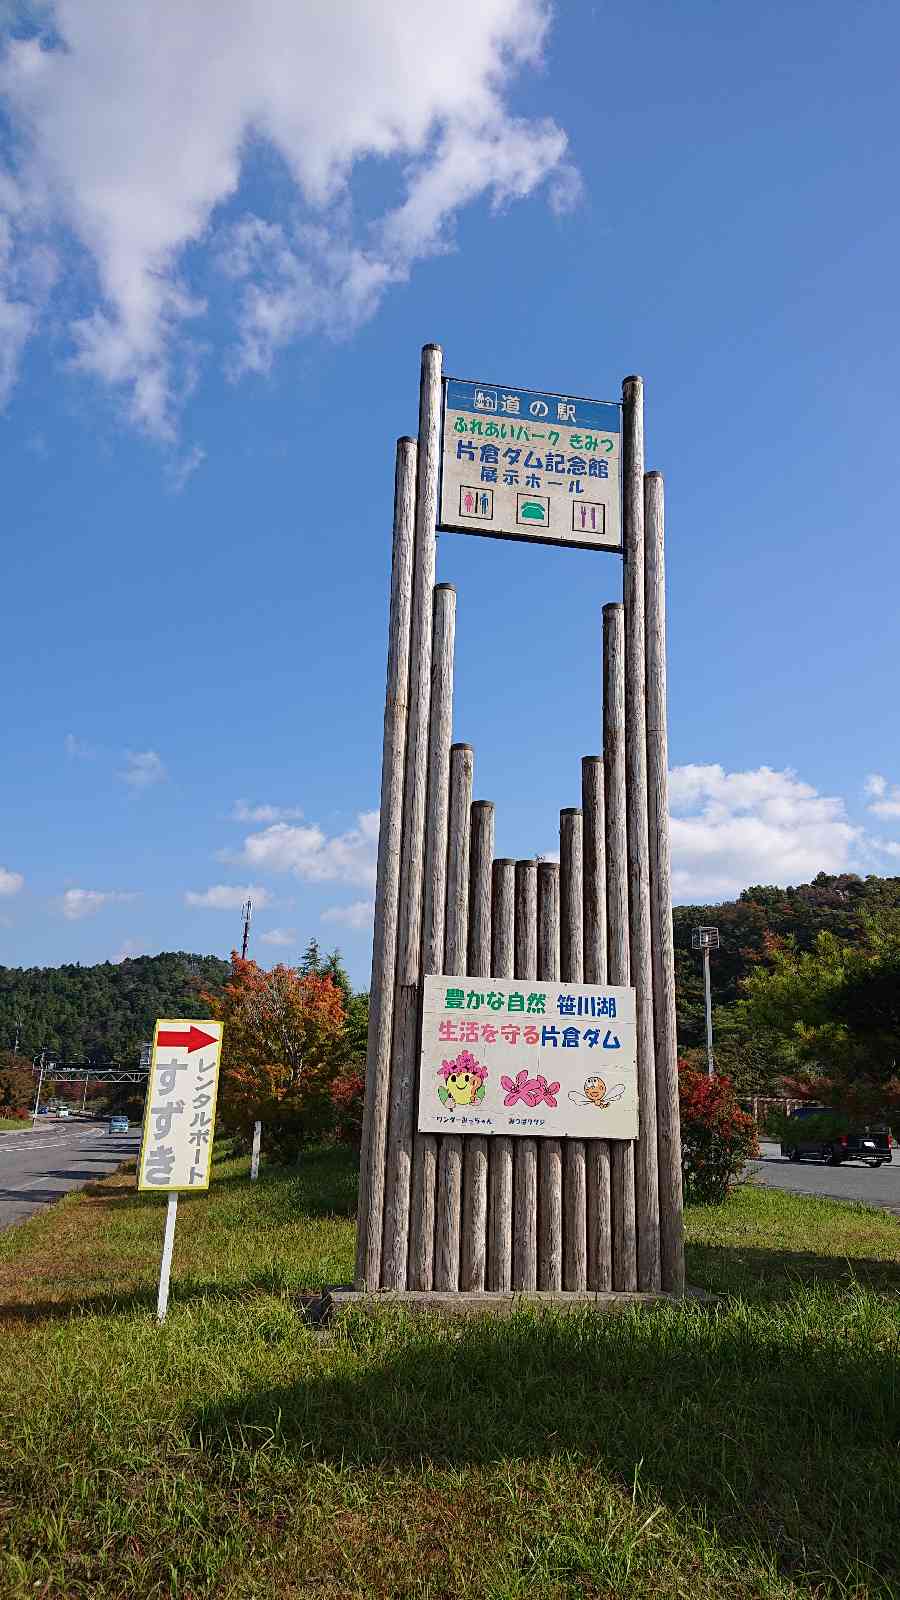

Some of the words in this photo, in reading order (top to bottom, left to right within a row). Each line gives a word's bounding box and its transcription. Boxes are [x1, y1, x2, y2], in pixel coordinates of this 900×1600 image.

[501, 394, 577, 423] 道の駅
[453, 417, 560, 446] ふれあいパーク
[569, 433, 614, 453] きみつ
[456, 439, 609, 479] 片倉ダム記念館
[480, 466, 585, 494] 展示ホール
[444, 988, 547, 1014] 豊かな自然
[556, 994, 617, 1018] 笹川湖
[437, 1020, 540, 1045] 生活を守る
[541, 1025, 621, 1049] 片倉ダム
[146, 1058, 187, 1184] すずき
[188, 1058, 216, 1185] レンタルボート
